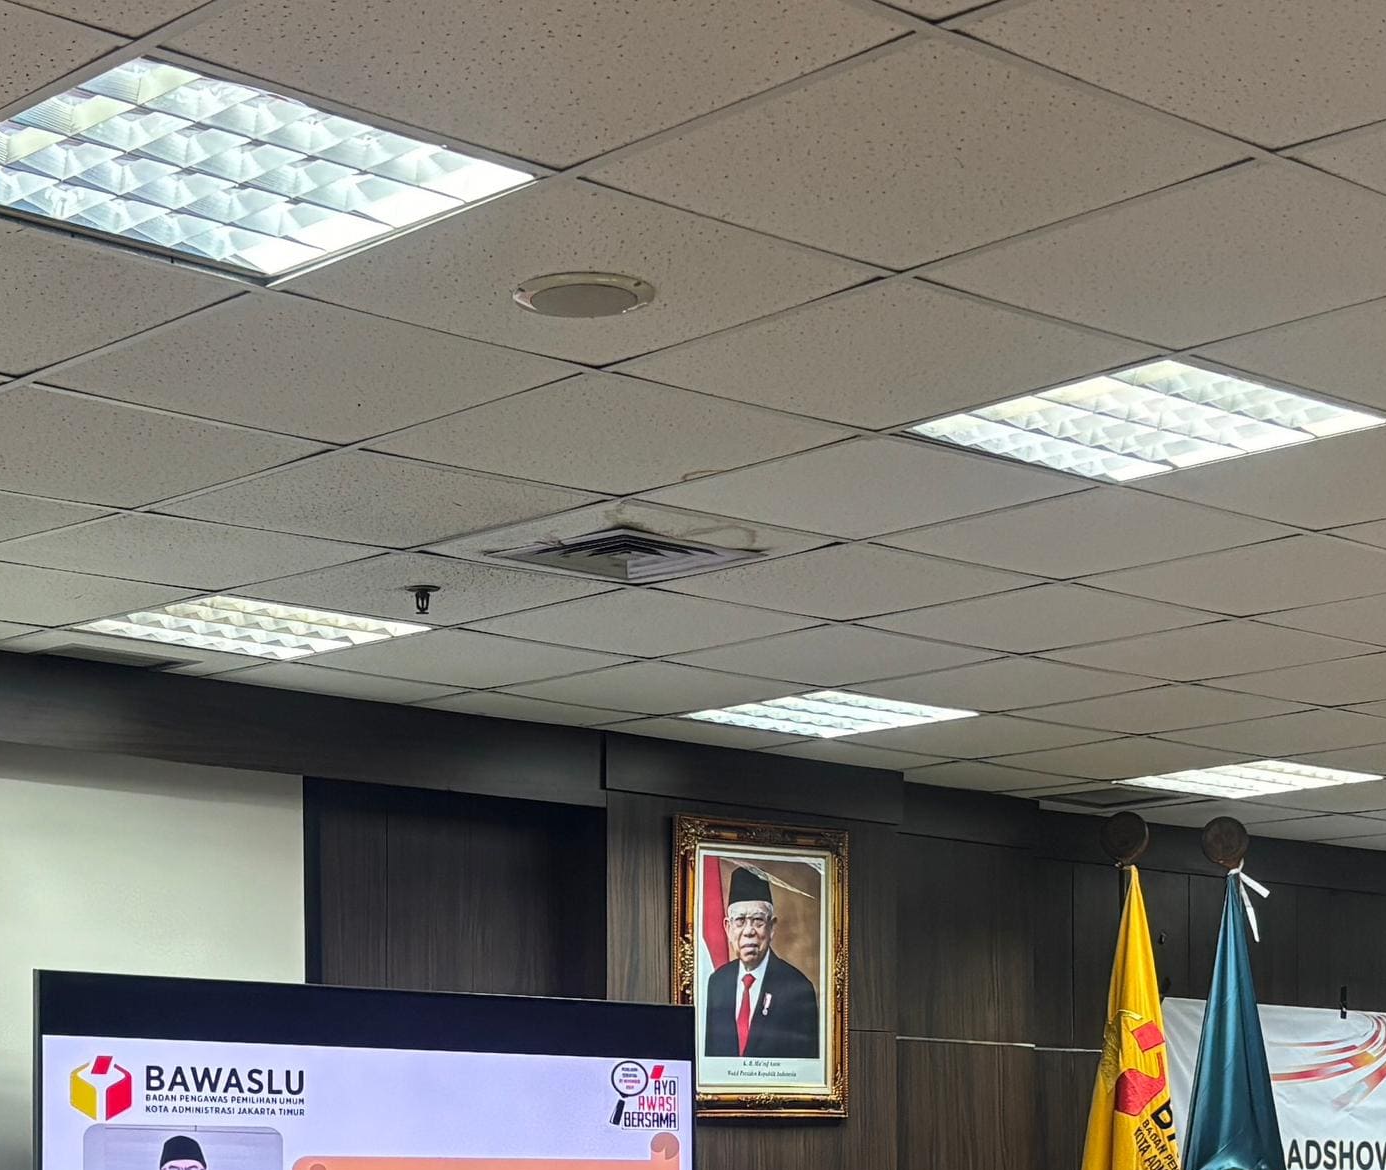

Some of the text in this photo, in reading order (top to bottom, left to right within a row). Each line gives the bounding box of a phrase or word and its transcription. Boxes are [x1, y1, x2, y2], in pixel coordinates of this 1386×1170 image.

[145, 1065, 305, 1095] BAWASLU
[654, 1080, 676, 1095] AYO
[146, 1094, 305, 1105] BADAN PENGAWAS PEMILIHAN UMUM
[638, 1096, 676, 1112] AWASI
[145, 1105, 305, 1116] KOTA ADMINISTRASI JAKARTA TIMUR
[624, 1112, 676, 1128] BERSAMA
